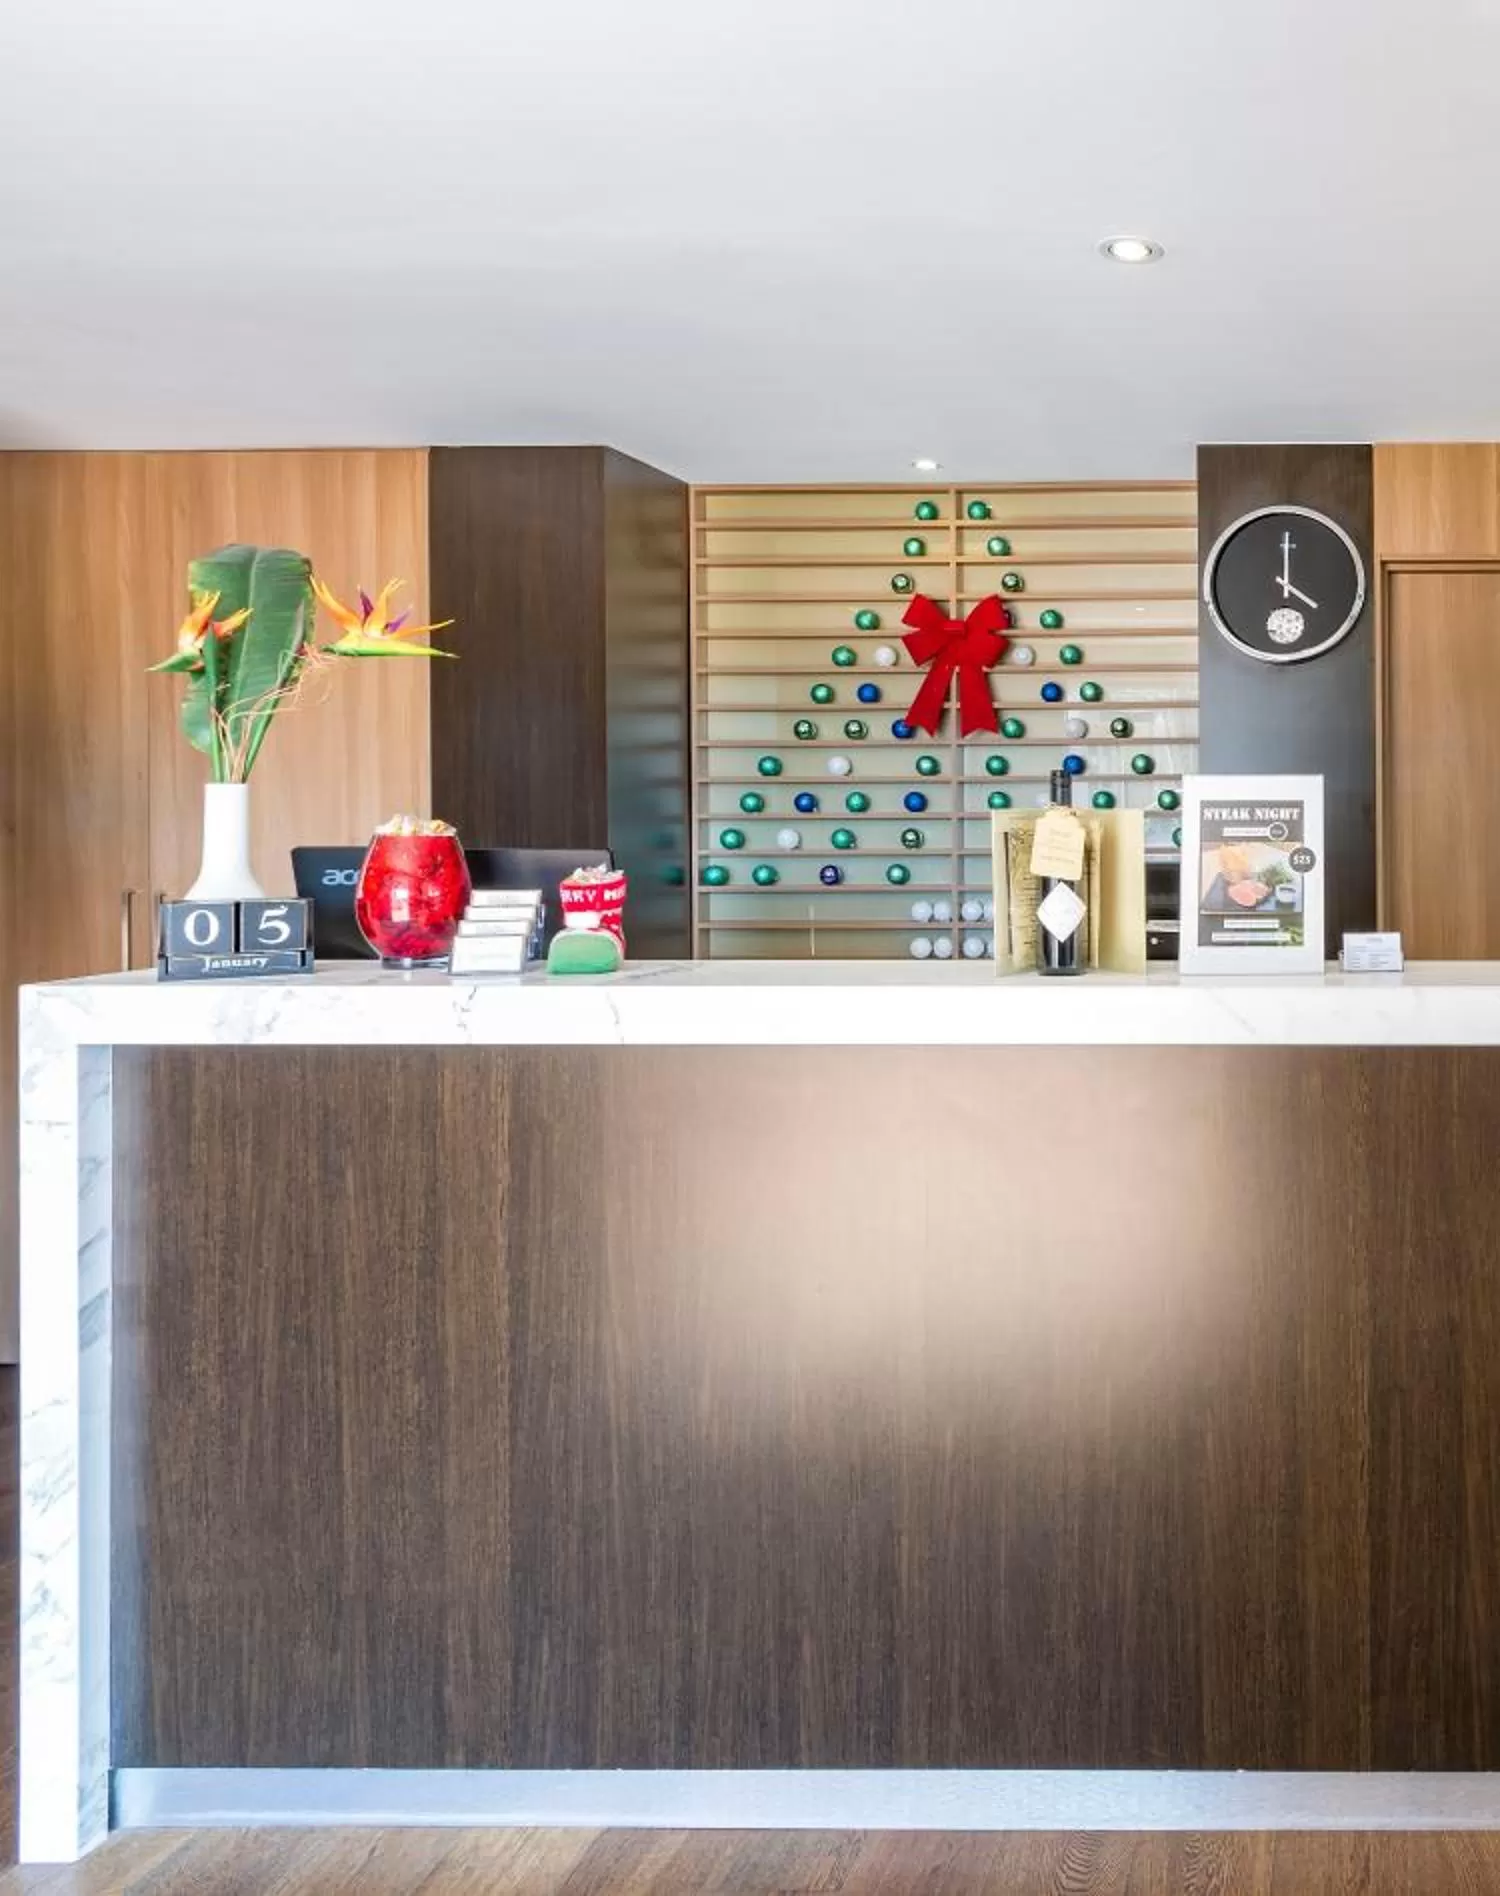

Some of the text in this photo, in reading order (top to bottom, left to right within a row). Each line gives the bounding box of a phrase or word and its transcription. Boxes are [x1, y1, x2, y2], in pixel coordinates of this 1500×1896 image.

[1203, 807, 1300, 821] STEAK NIGHT
[322, 869, 359, 886] ac
[202, 956, 269, 972] January
